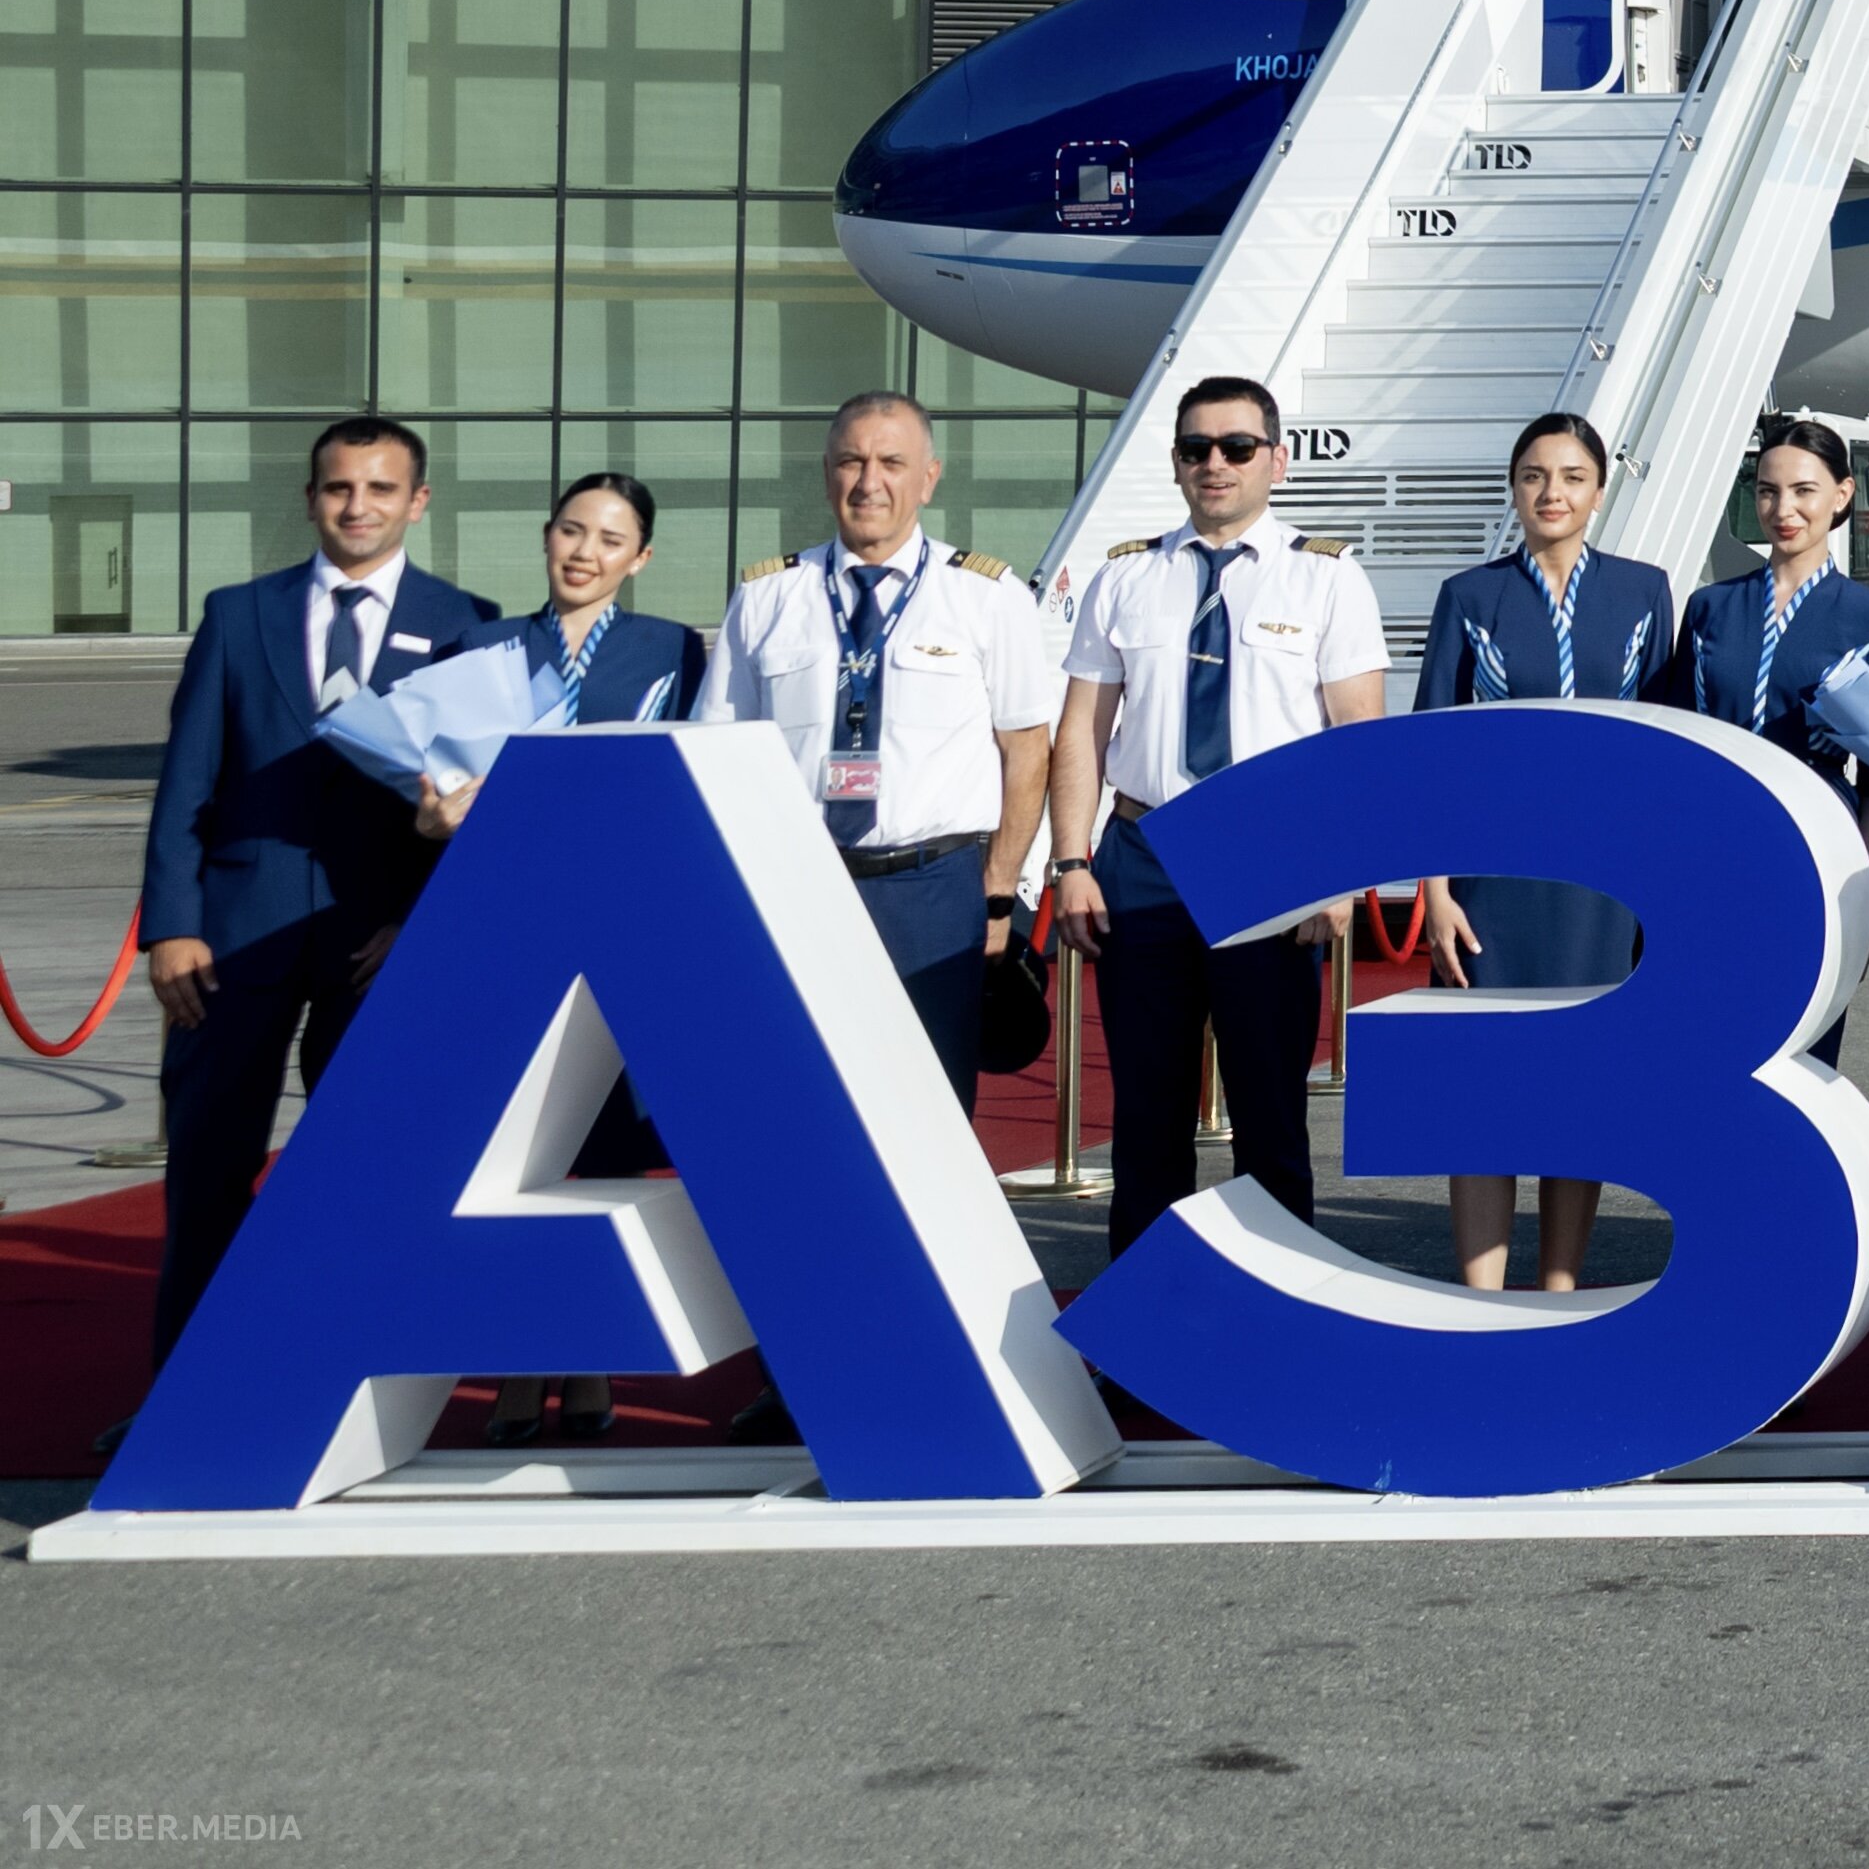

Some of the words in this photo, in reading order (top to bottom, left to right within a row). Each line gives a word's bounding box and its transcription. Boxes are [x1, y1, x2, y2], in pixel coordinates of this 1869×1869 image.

[1474, 144, 1532, 170] TLD
[1396, 209, 1457, 236] TLD
[1286, 428, 1351, 461] TLD
